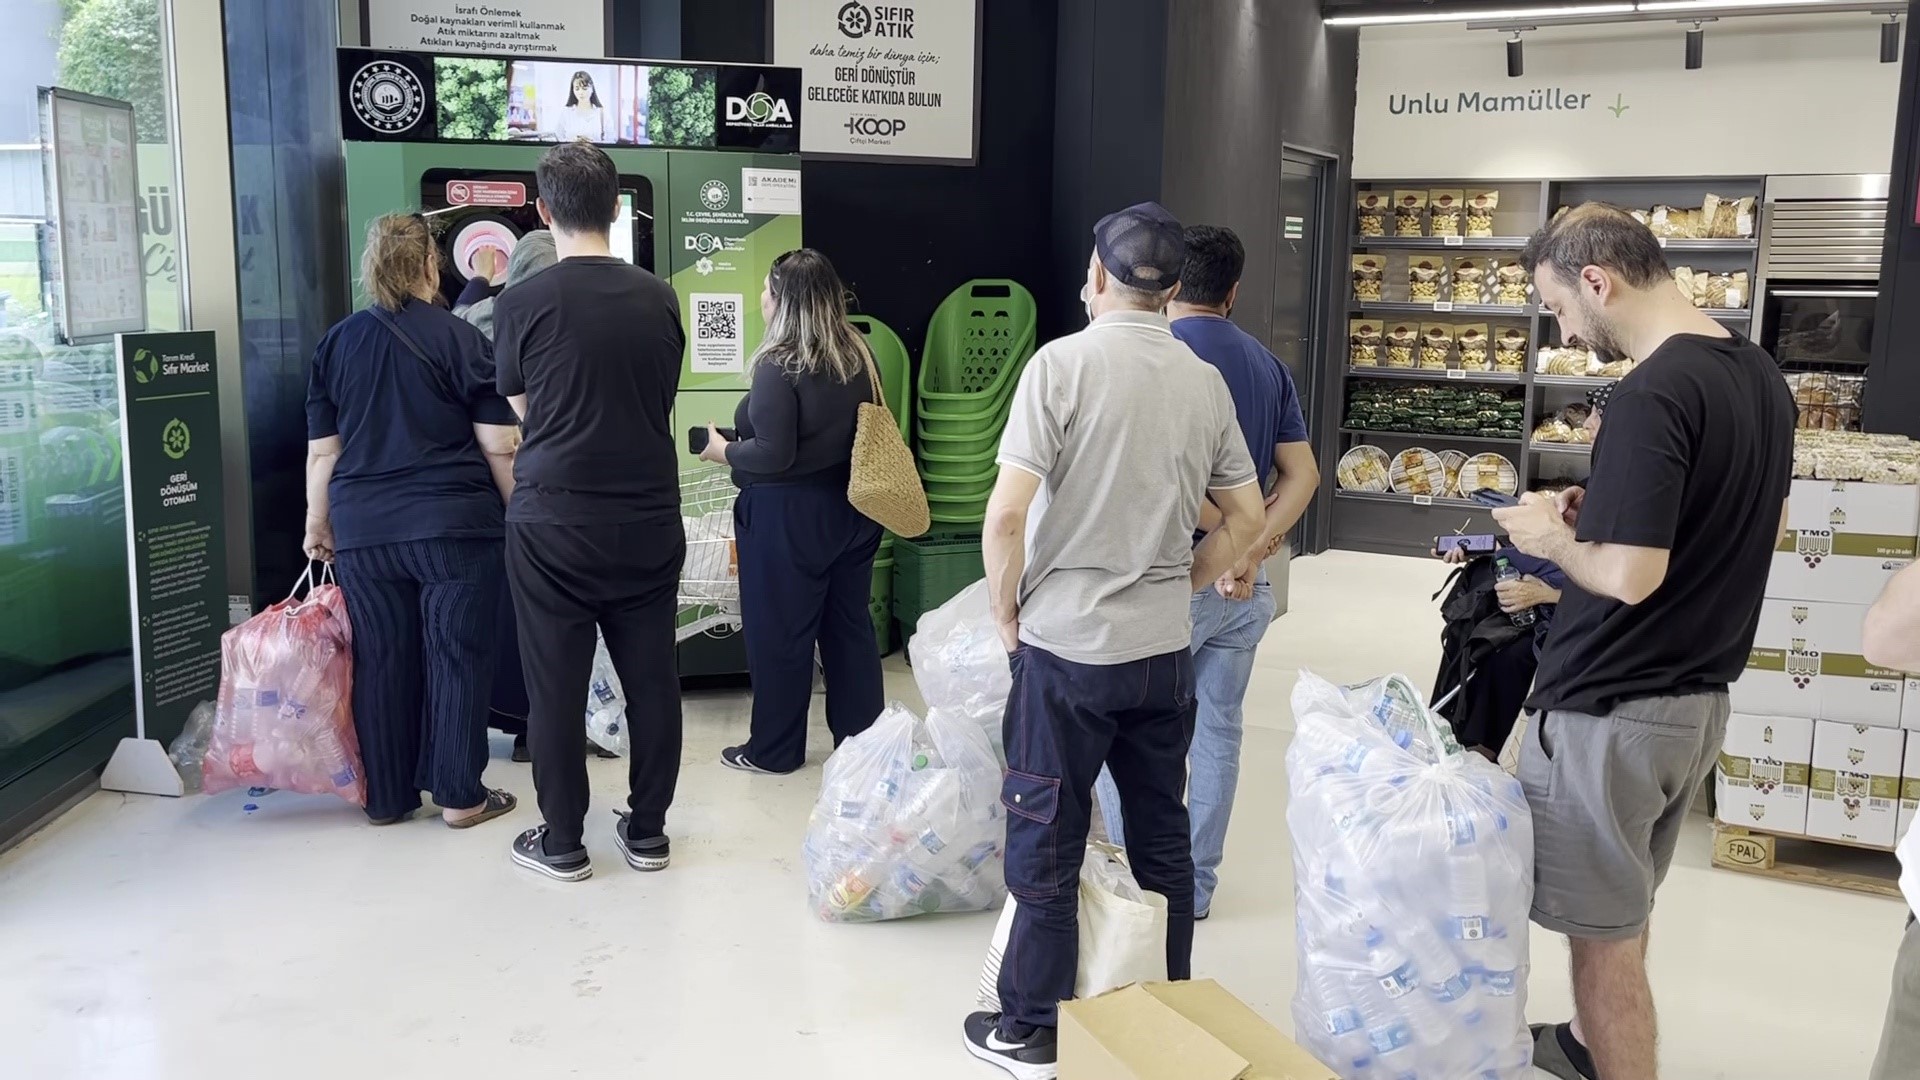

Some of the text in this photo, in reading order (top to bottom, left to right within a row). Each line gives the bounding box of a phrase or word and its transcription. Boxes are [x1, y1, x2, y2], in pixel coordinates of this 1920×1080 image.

[455, 5, 522, 18] İsrafı Önlemek
[875, 6, 914, 22] SIFIR
[411, 13, 565, 31] Doğal kaynakları verimli kullanmak
[437, 27, 540, 40] Atık miktarını azaltmak
[875, 22, 914, 39] ATIK
[420, 36, 453, 47] Atıkları
[455, 38, 506, 50] kaynağında
[508, 41, 557, 52] ayrıştırmak
[809, 43, 835, 57] daha
[838, 45, 866, 64] temiz
[867, 46, 882, 60] bir
[883, 48, 915, 66] dünya
[835, 64, 915, 87] GERİ DÖNÜŞTÜR
[808, 85, 941, 107] GELECEĞE KATKIDA BULUN
[1389, 88, 1591, 115] Unlu Mamüller
[180, 353, 195, 361] Kredi
[180, 362, 210, 374] Market
[170, 470, 188, 483] GERİ
[160, 482, 198, 496] DÖNÜŞÜM
[163, 493, 197, 507] OTOMATI
[1800, 529, 1831, 537] TMO
